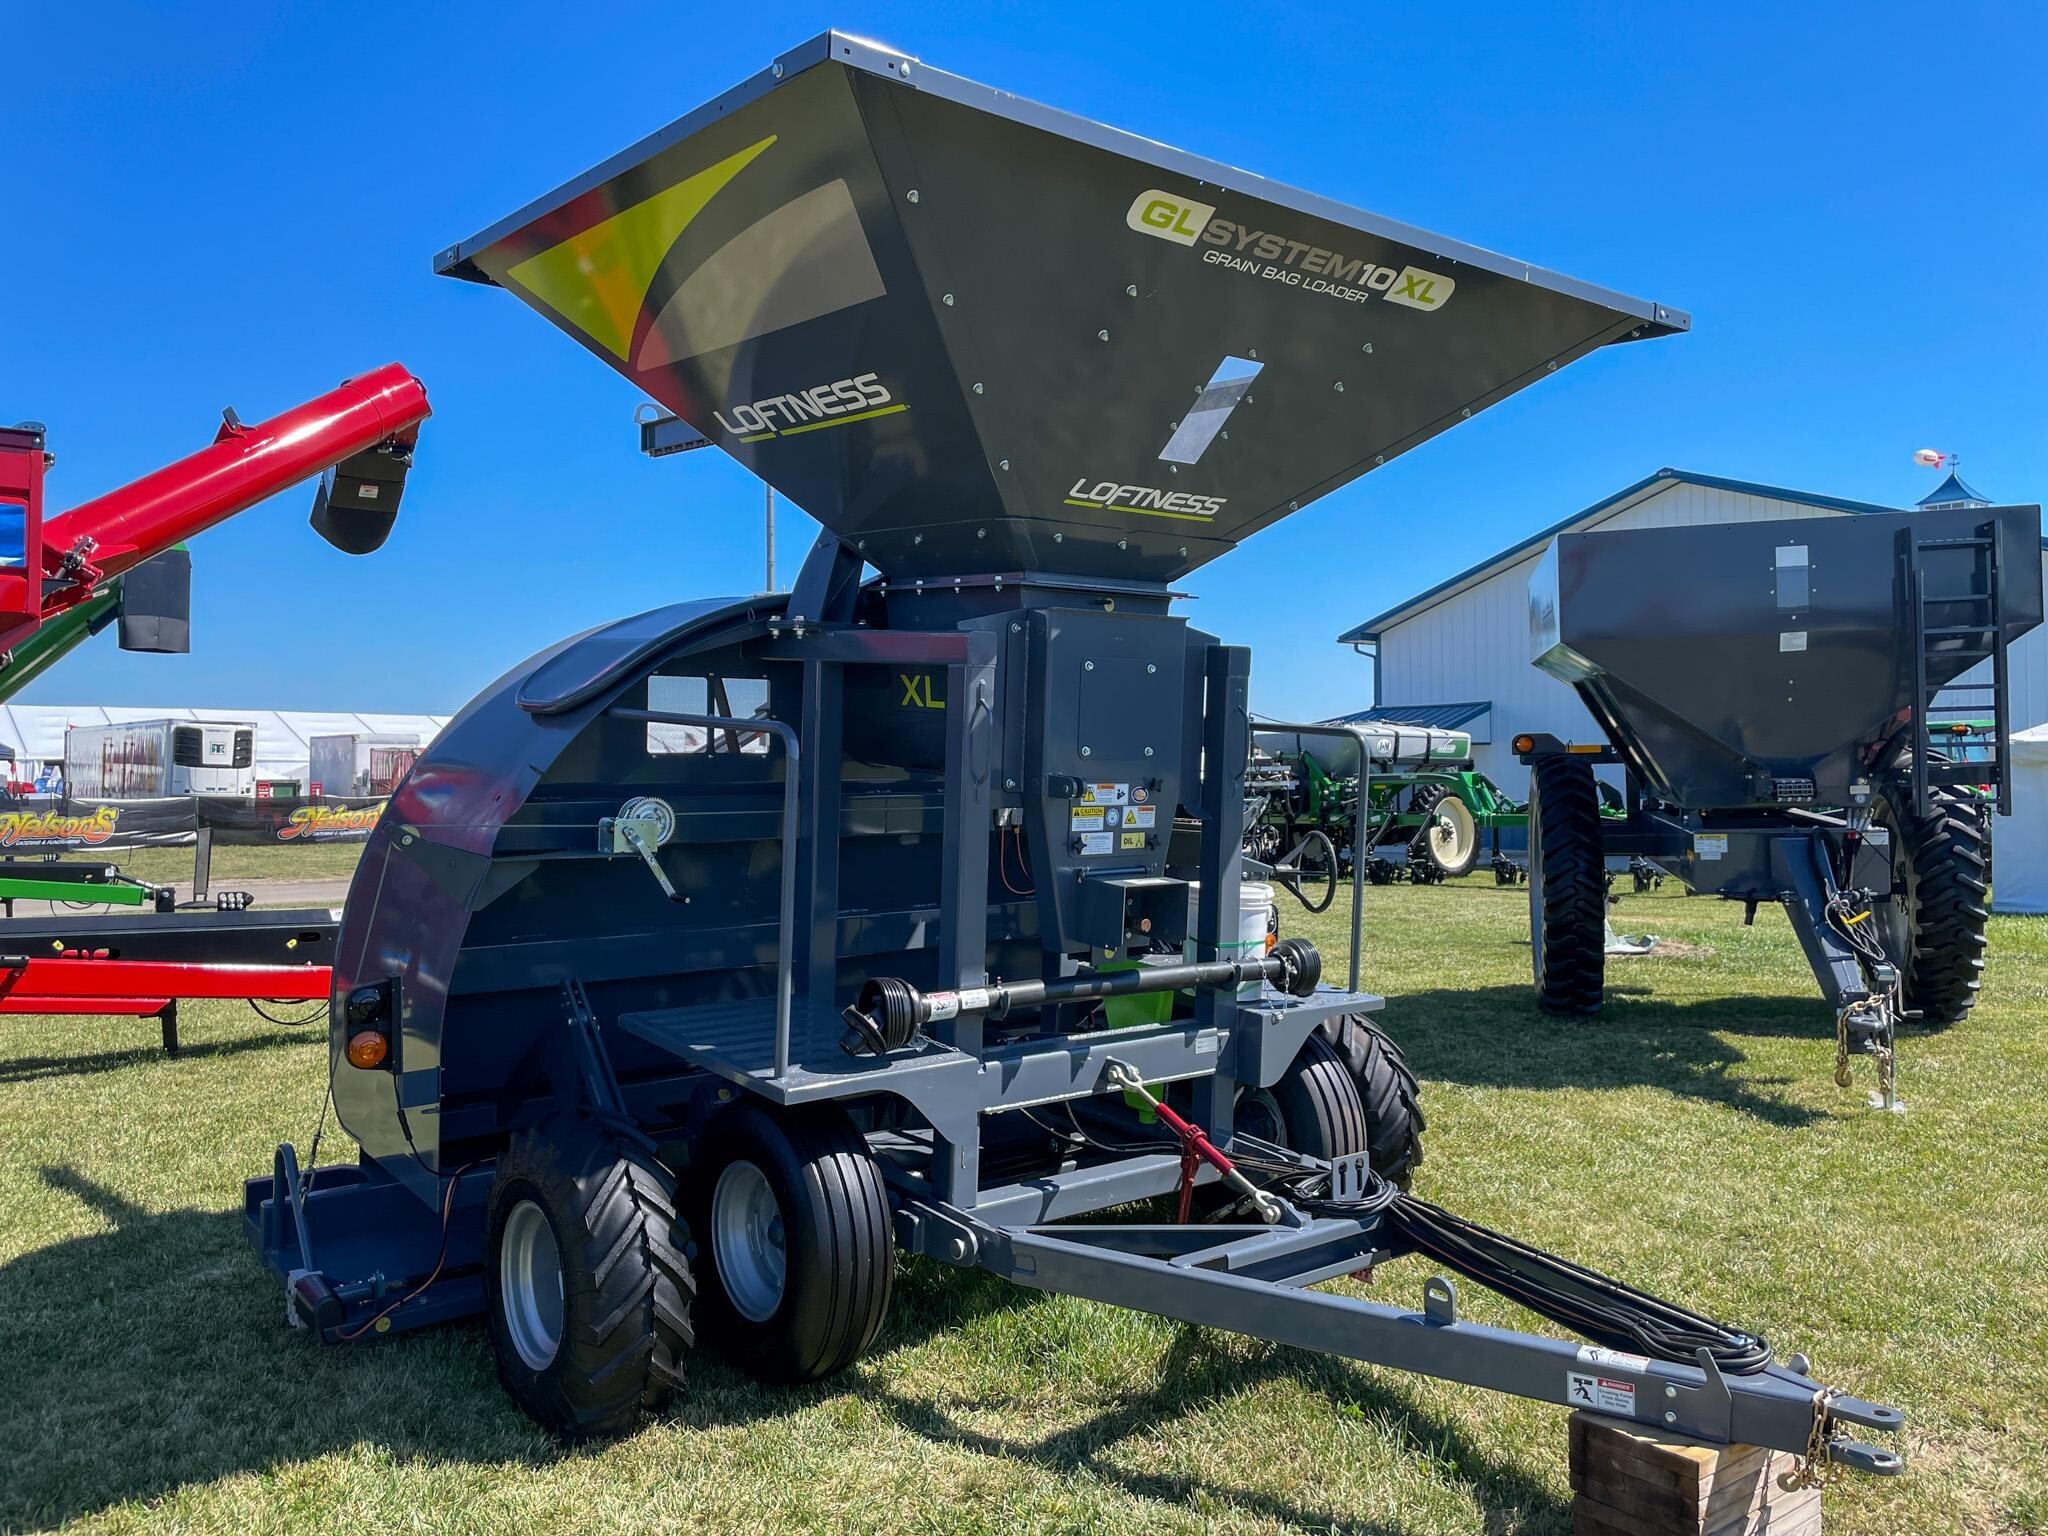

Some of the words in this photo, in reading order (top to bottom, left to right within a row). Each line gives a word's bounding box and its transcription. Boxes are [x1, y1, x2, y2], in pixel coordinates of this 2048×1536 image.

[1203, 250, 1261, 275] GRAIN
[1262, 266, 1301, 285] BAG
[1302, 277, 1369, 303] LOADER
[713, 372, 891, 434] LOFTNESS
[1069, 478, 1228, 515] LOFTNESS
[900, 674, 945, 708] XL
[1124, 837, 1133, 845] OIL
[1607, 1382, 1630, 1390] DANGER
